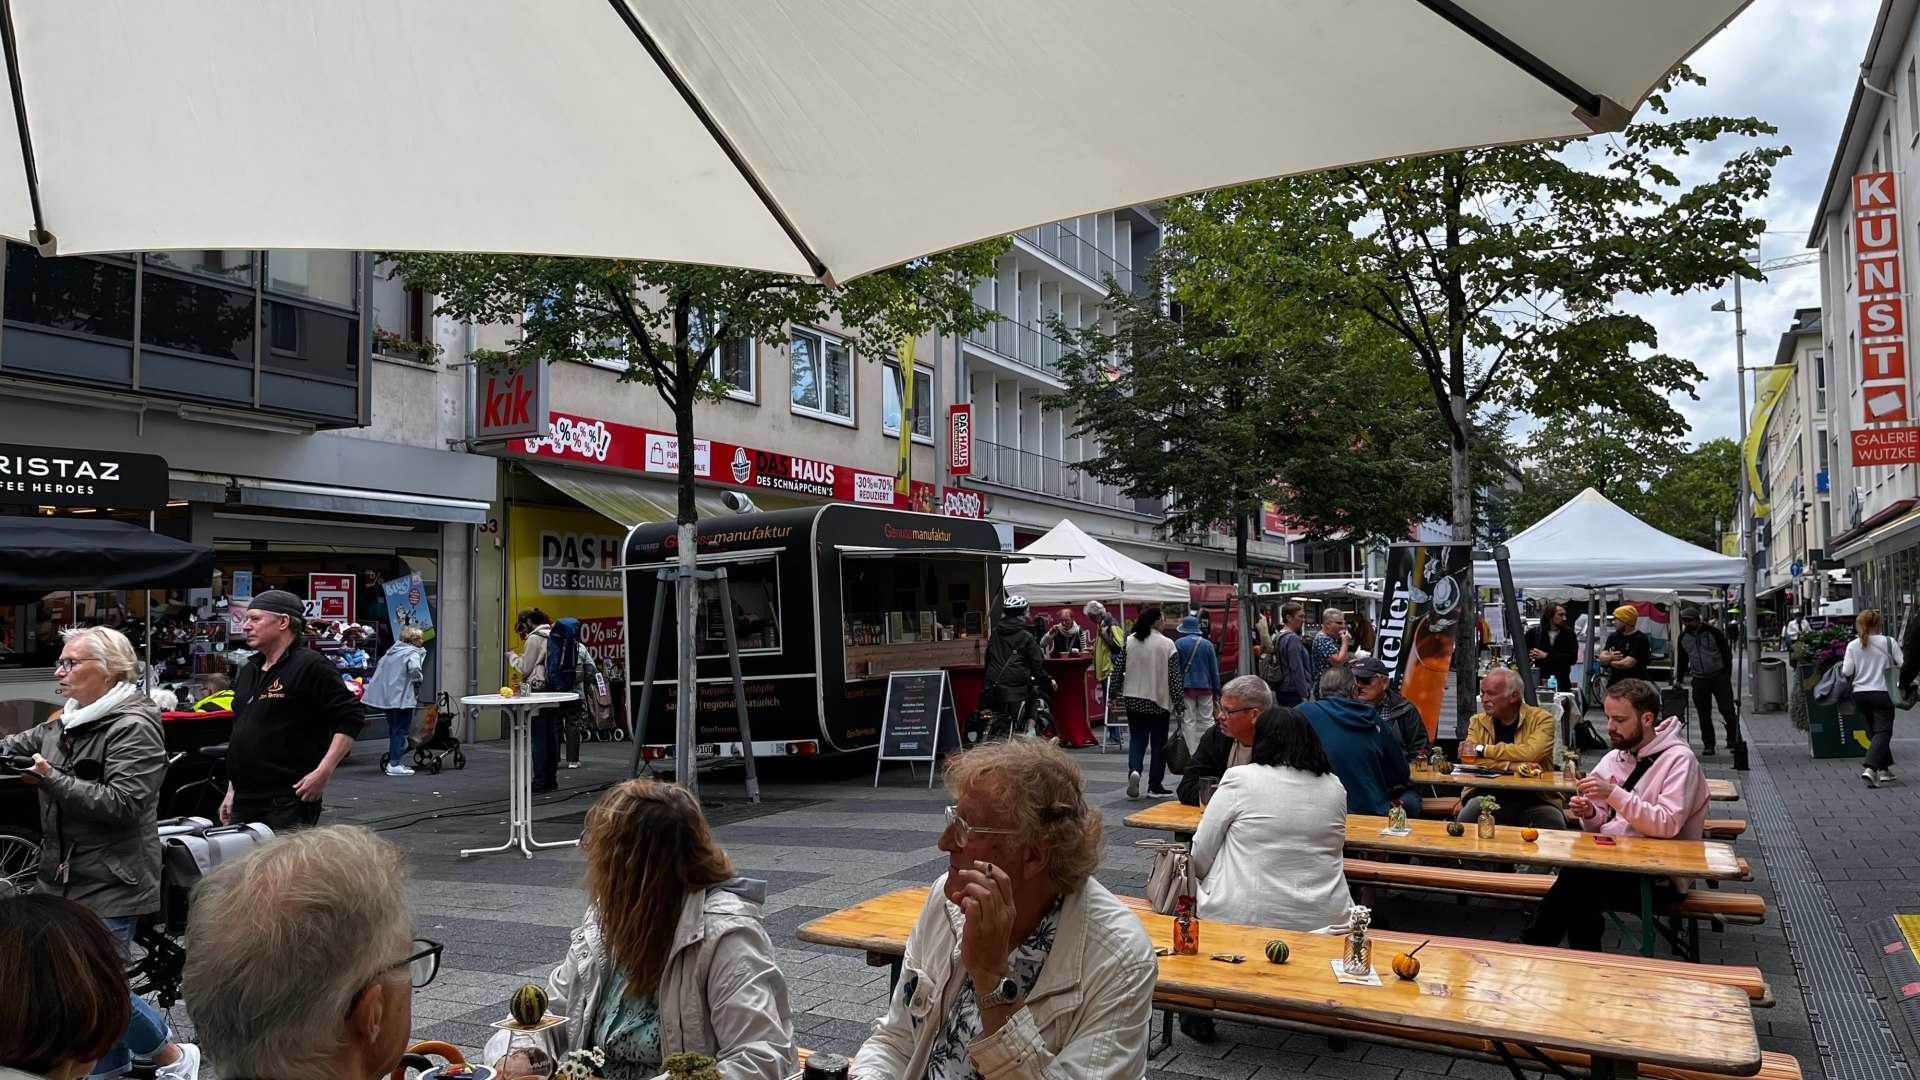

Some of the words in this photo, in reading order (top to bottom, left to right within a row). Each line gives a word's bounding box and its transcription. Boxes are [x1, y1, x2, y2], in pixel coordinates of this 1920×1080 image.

[1859, 176, 1898, 375] KUNST
[1855, 431, 1918, 446] GALERIE
[960, 436, 968, 466] HAUS
[1858, 447, 1916, 460] WUTZKE
[756, 451, 788, 475] DAS
[791, 457, 835, 484] HAUS
[33, 483, 94, 495] HEROES
[757, 475, 771, 487] DES
[773, 478, 833, 496] SCHNÄPPCHEN'S
[878, 479, 893, 492] 70%
[859, 490, 889, 501] REDUZIERT
[884, 523, 952, 542] Genussmanufaktur
[543, 535, 596, 568] DAS
[544, 573, 567, 587] DES
[1259, 583, 1300, 592] OTIK
[580, 622, 605, 643] 0%
[606, 628, 617, 638] BIS
[1380, 581, 1410, 681] telier
[744, 683, 775, 694] intöpfe
